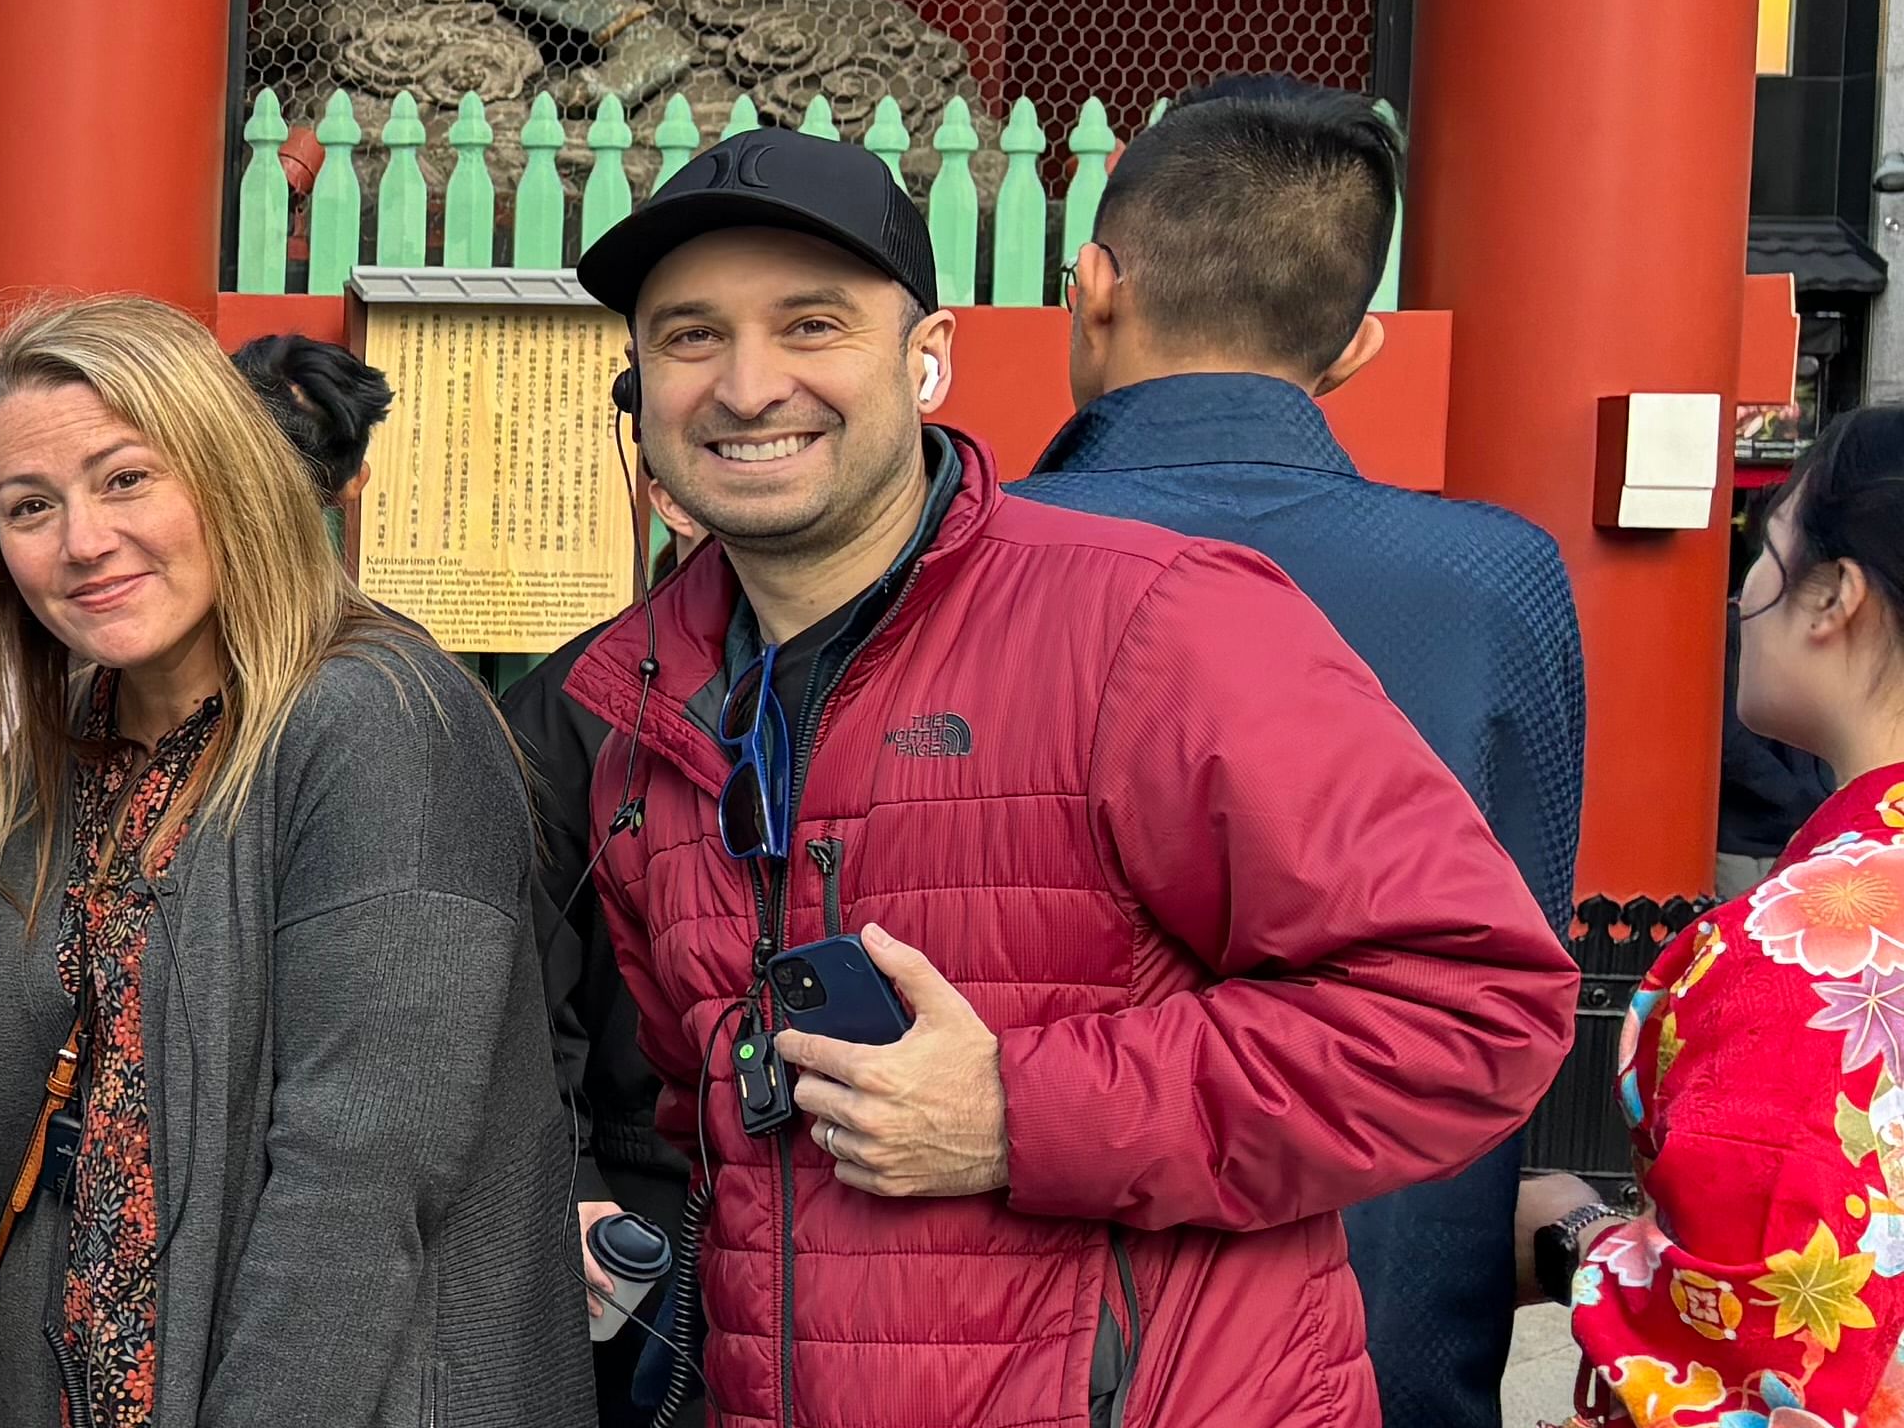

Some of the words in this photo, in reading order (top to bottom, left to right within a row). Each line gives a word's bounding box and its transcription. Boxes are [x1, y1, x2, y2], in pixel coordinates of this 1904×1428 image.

[439, 555, 463, 566] Gate
[912, 714, 945, 728] THE
[884, 727, 943, 745] NORTH
[896, 743, 941, 757] FACE
